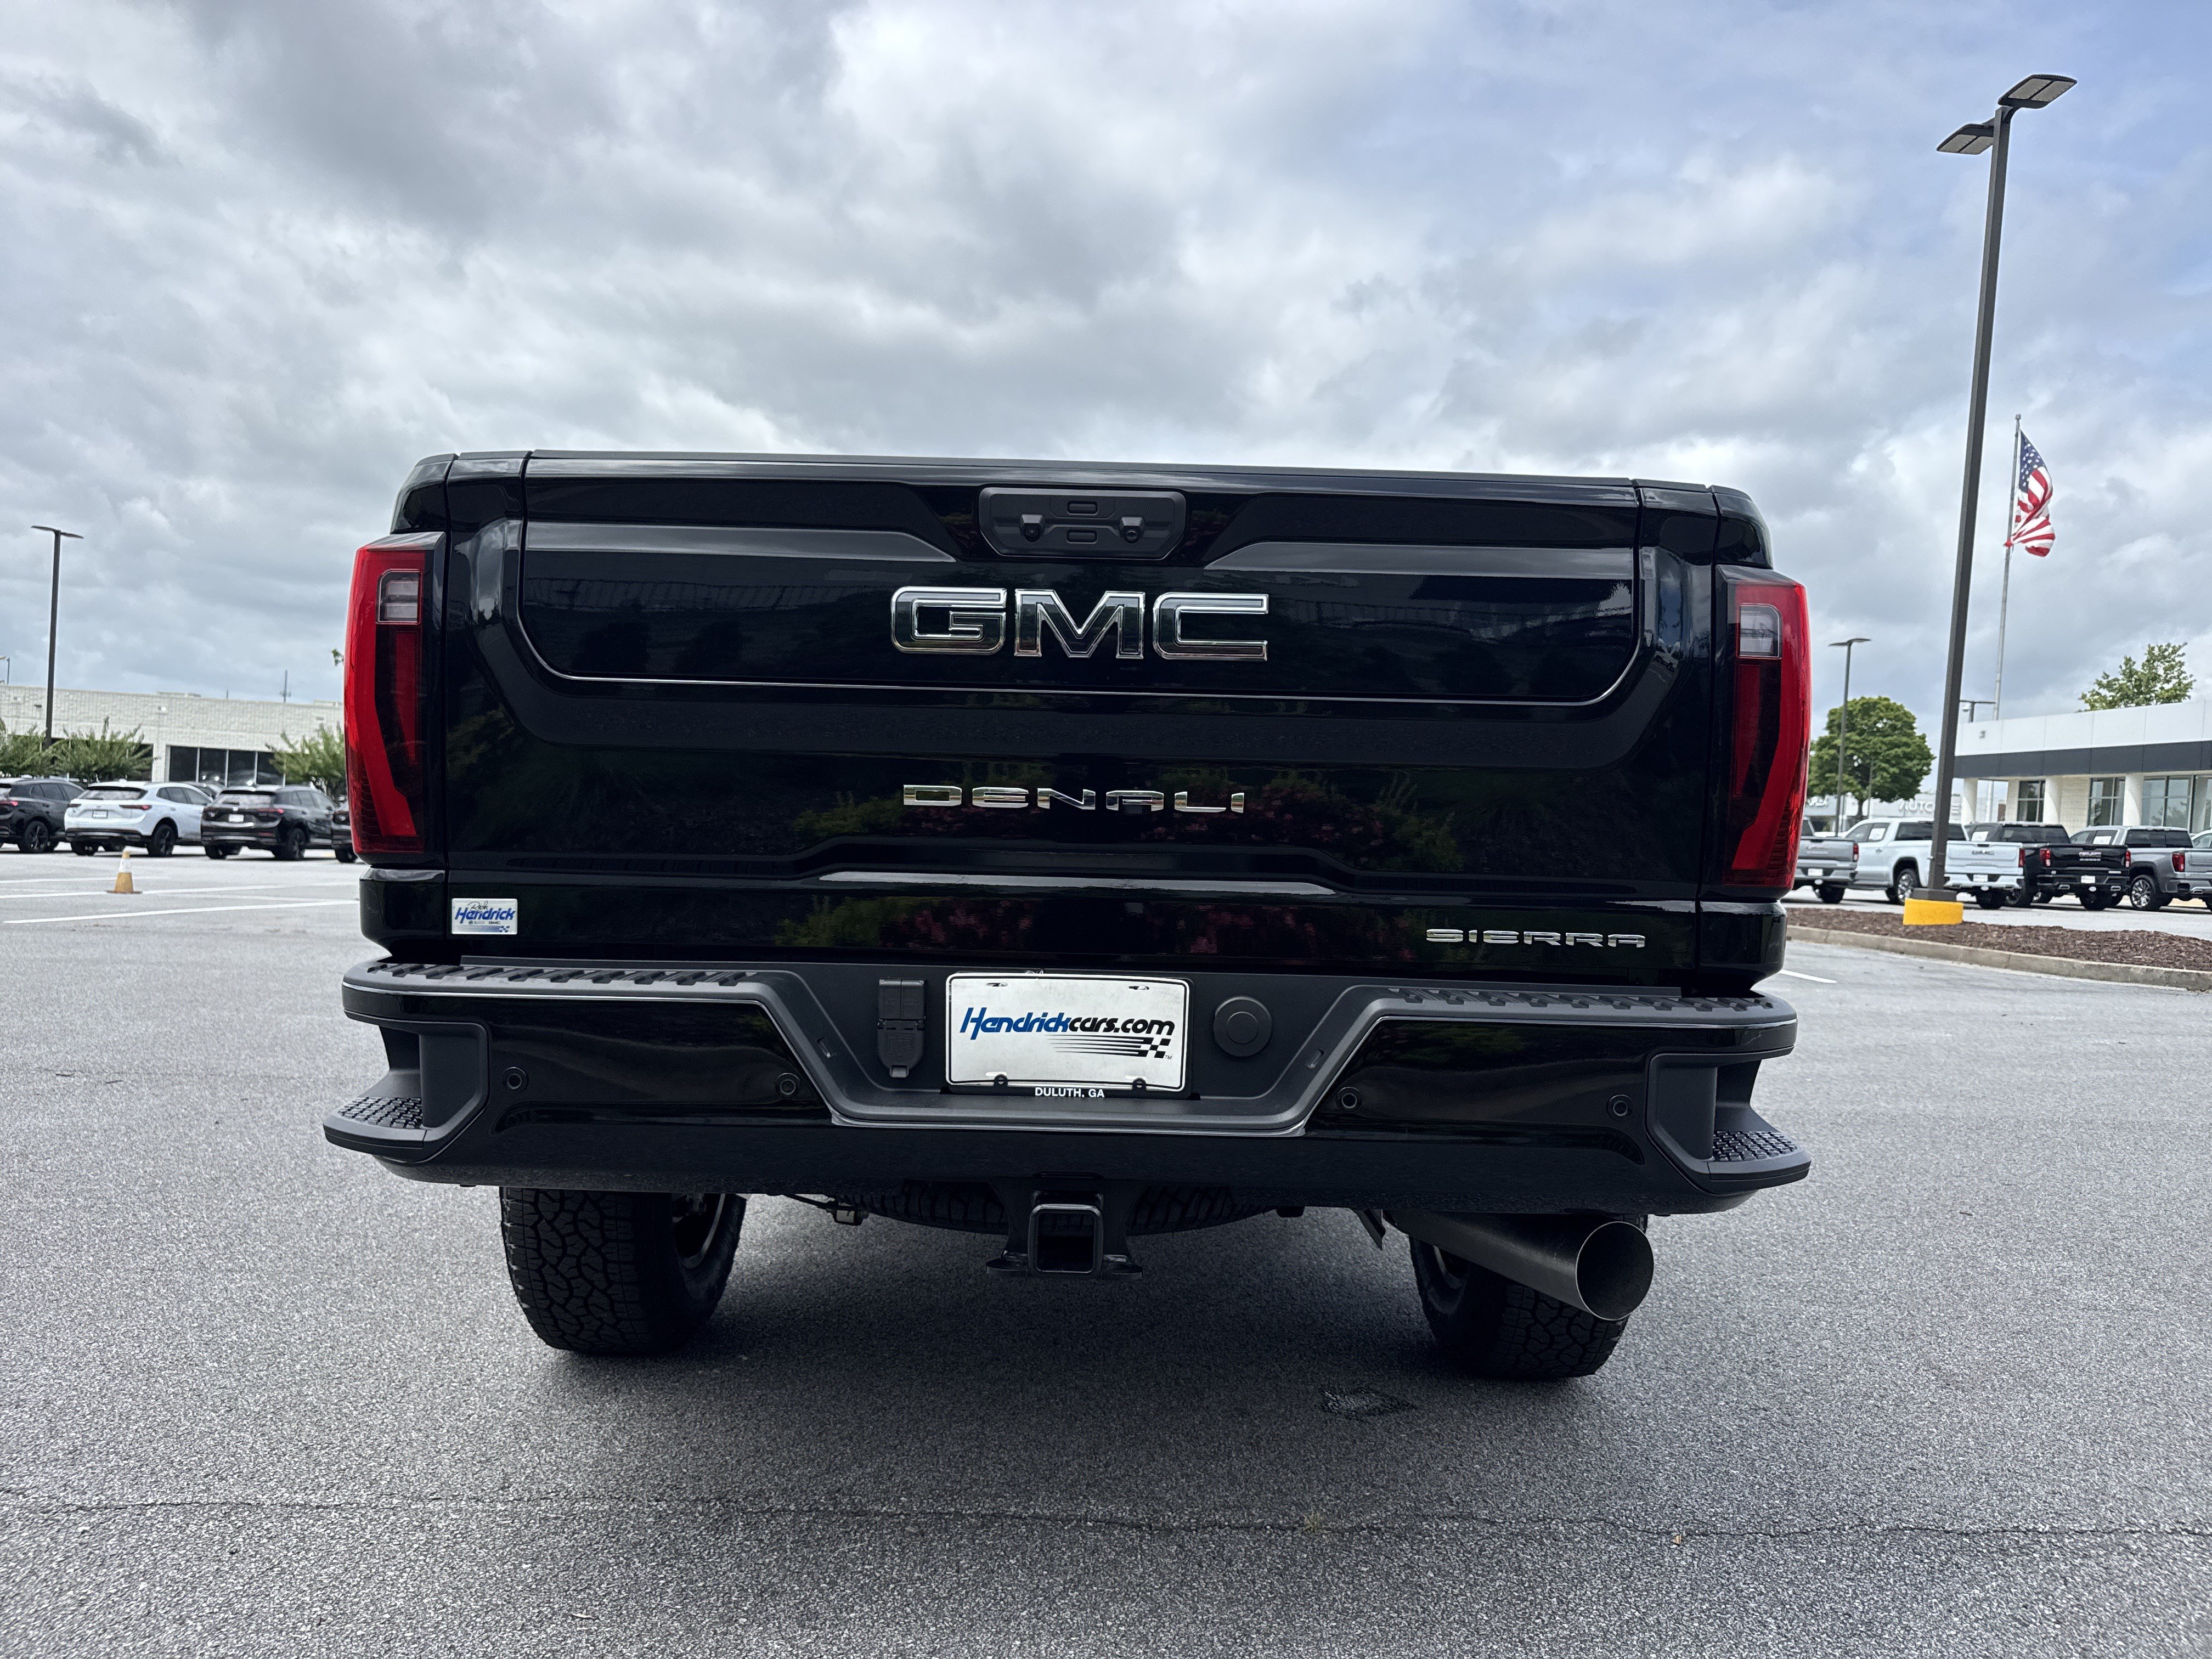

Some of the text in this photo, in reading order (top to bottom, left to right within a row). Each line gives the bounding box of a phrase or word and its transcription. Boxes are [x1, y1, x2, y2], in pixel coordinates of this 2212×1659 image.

[890, 586, 1269, 661] GMC
[903, 784, 1245, 814] DENALI
[454, 907, 516, 924] Hendrick
[1426, 928, 1646, 948] SIERRA
[960, 1007, 1176, 1040] Hendrickcars.com
[1088, 1088, 1105, 1098] GA
